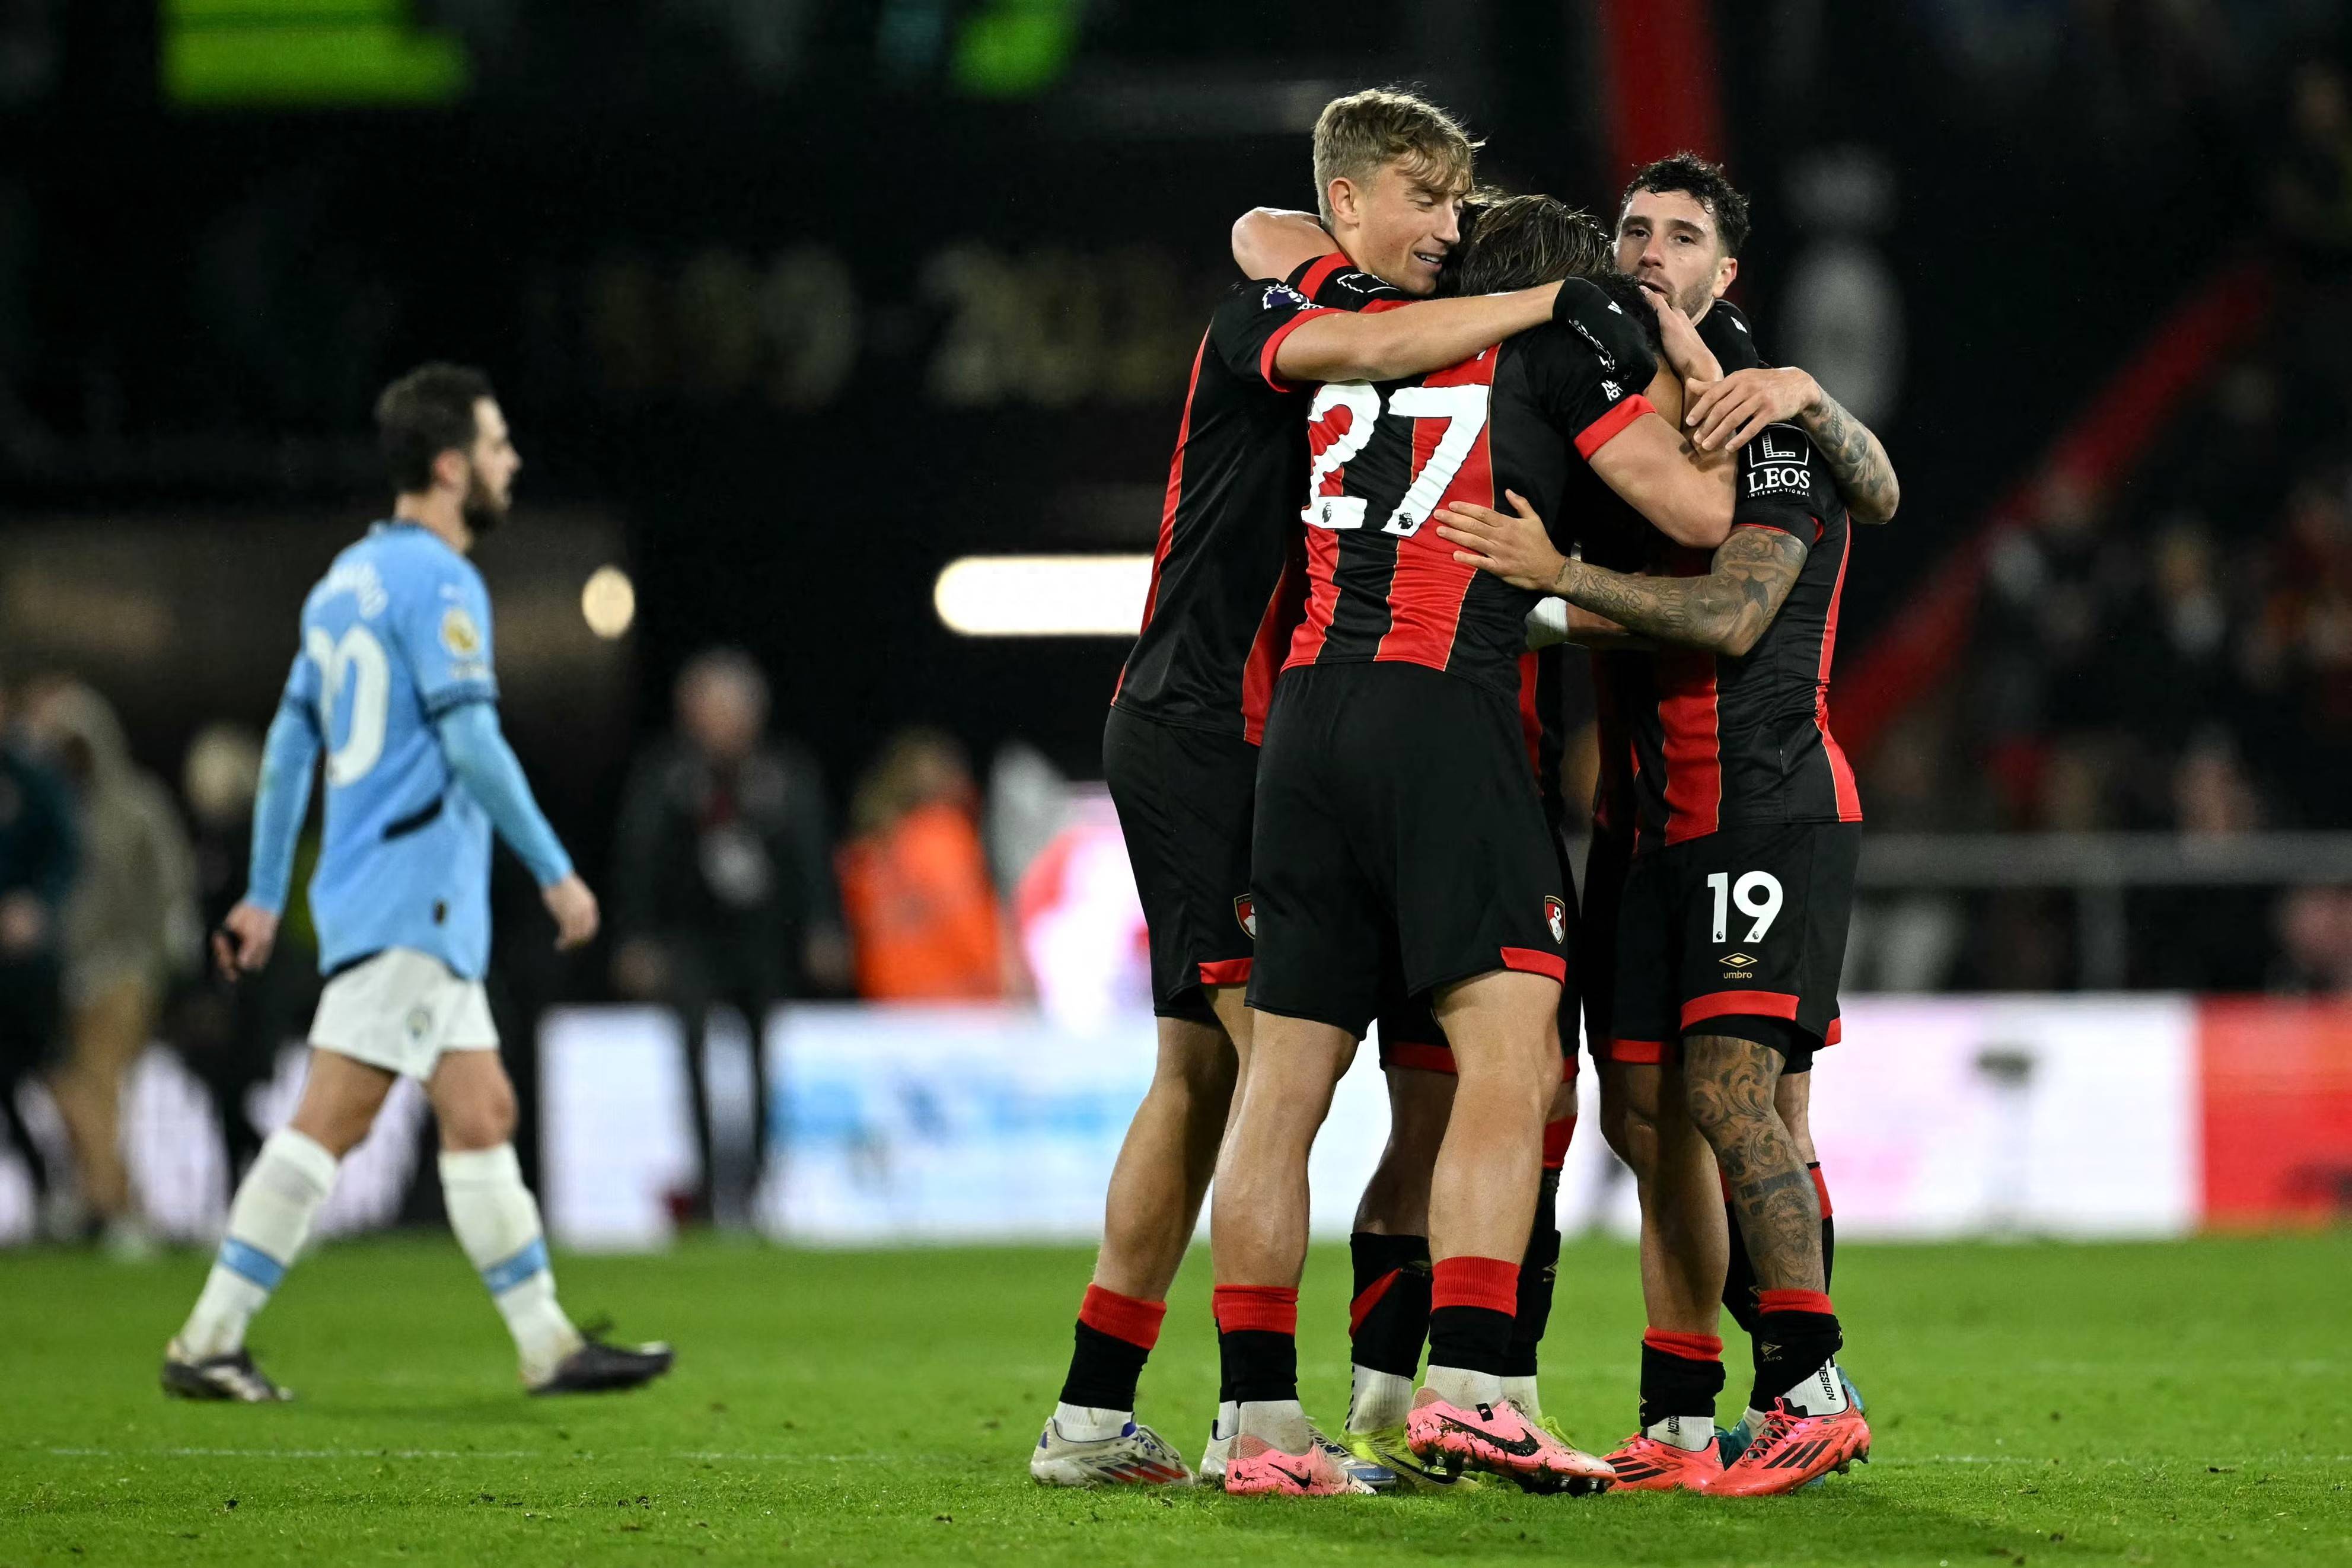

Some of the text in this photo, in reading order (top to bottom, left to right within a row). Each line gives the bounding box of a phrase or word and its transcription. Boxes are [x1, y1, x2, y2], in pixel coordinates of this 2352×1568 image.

[1301, 380, 1490, 537] 27
[1747, 467, 1811, 493] LEOS
[1747, 488, 1809, 499] INTERNATIONAL
[1707, 871, 1783, 943] 19
[1723, 970, 1752, 979] umbro
